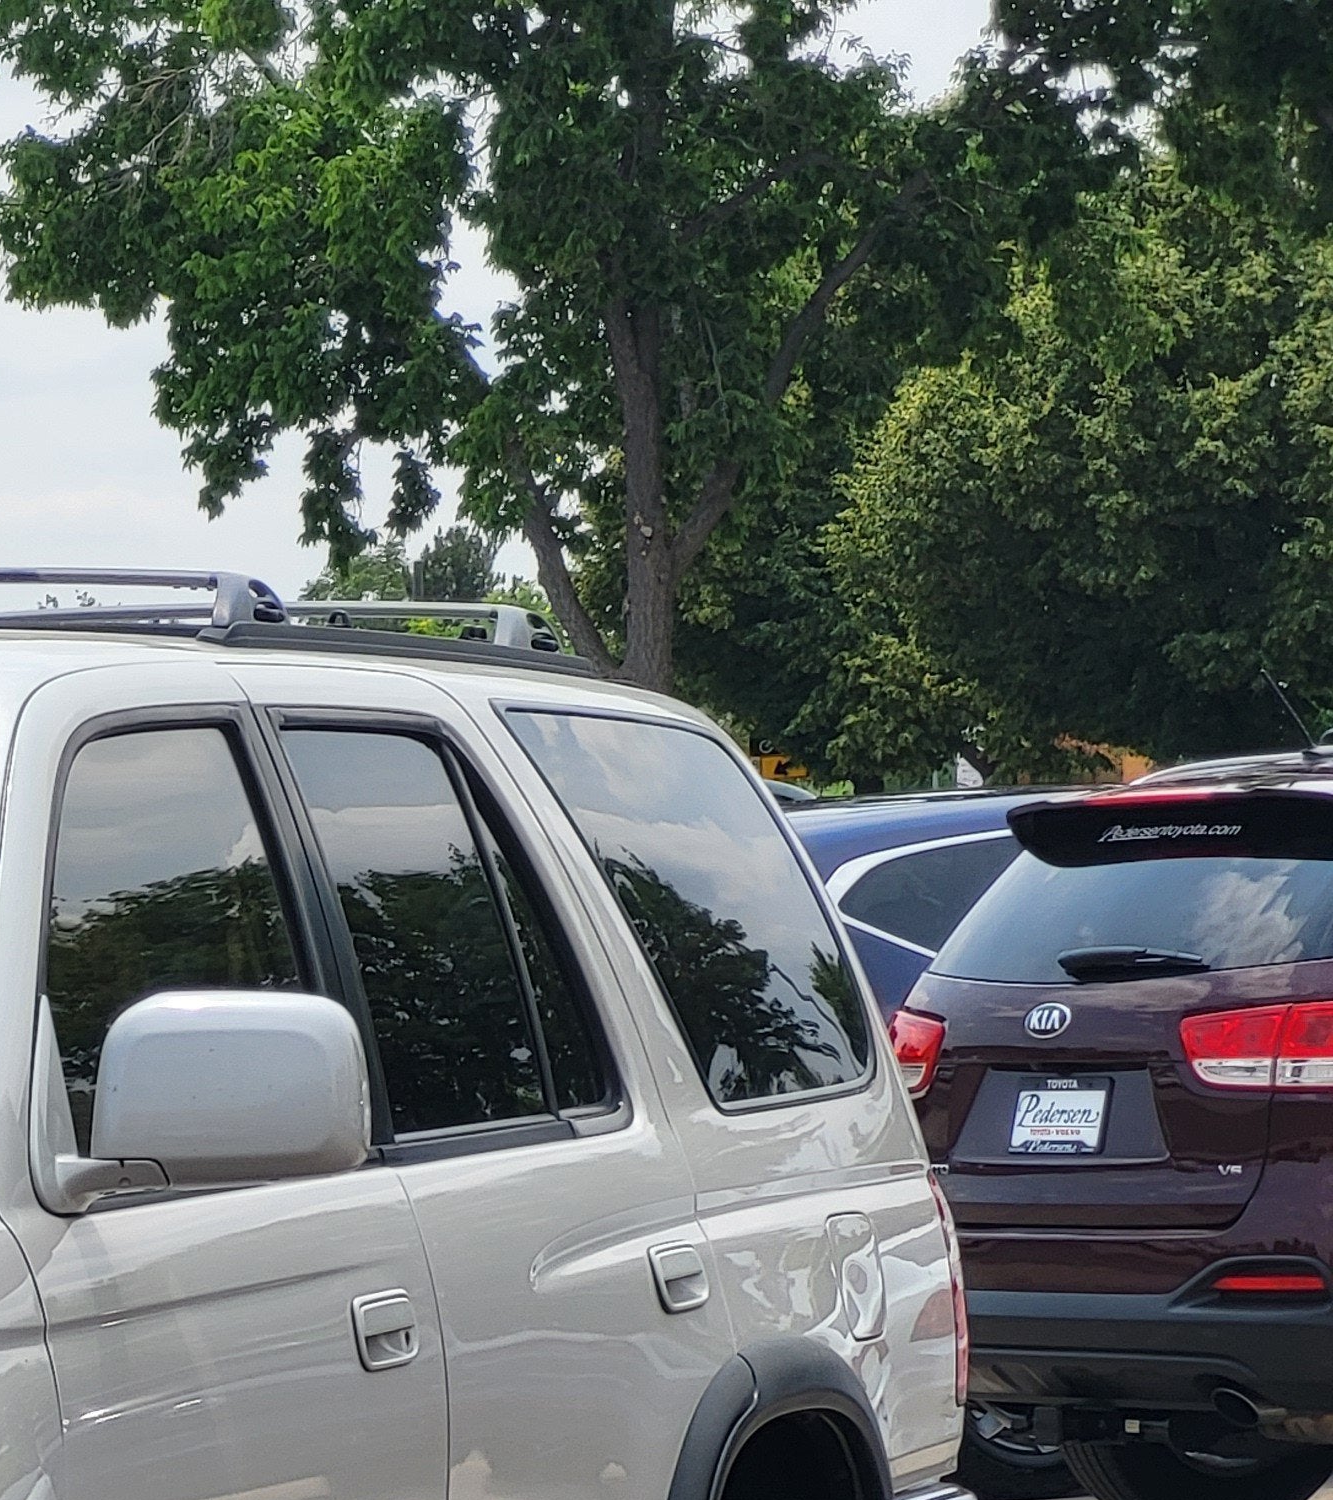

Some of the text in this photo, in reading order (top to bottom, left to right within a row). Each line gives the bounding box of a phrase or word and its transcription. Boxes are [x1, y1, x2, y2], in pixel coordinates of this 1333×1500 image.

[1029, 1009, 1061, 1030] KIA
[1046, 1079, 1079, 1089] TOYOTA
[1017, 1093, 1100, 1128] Pedersen
